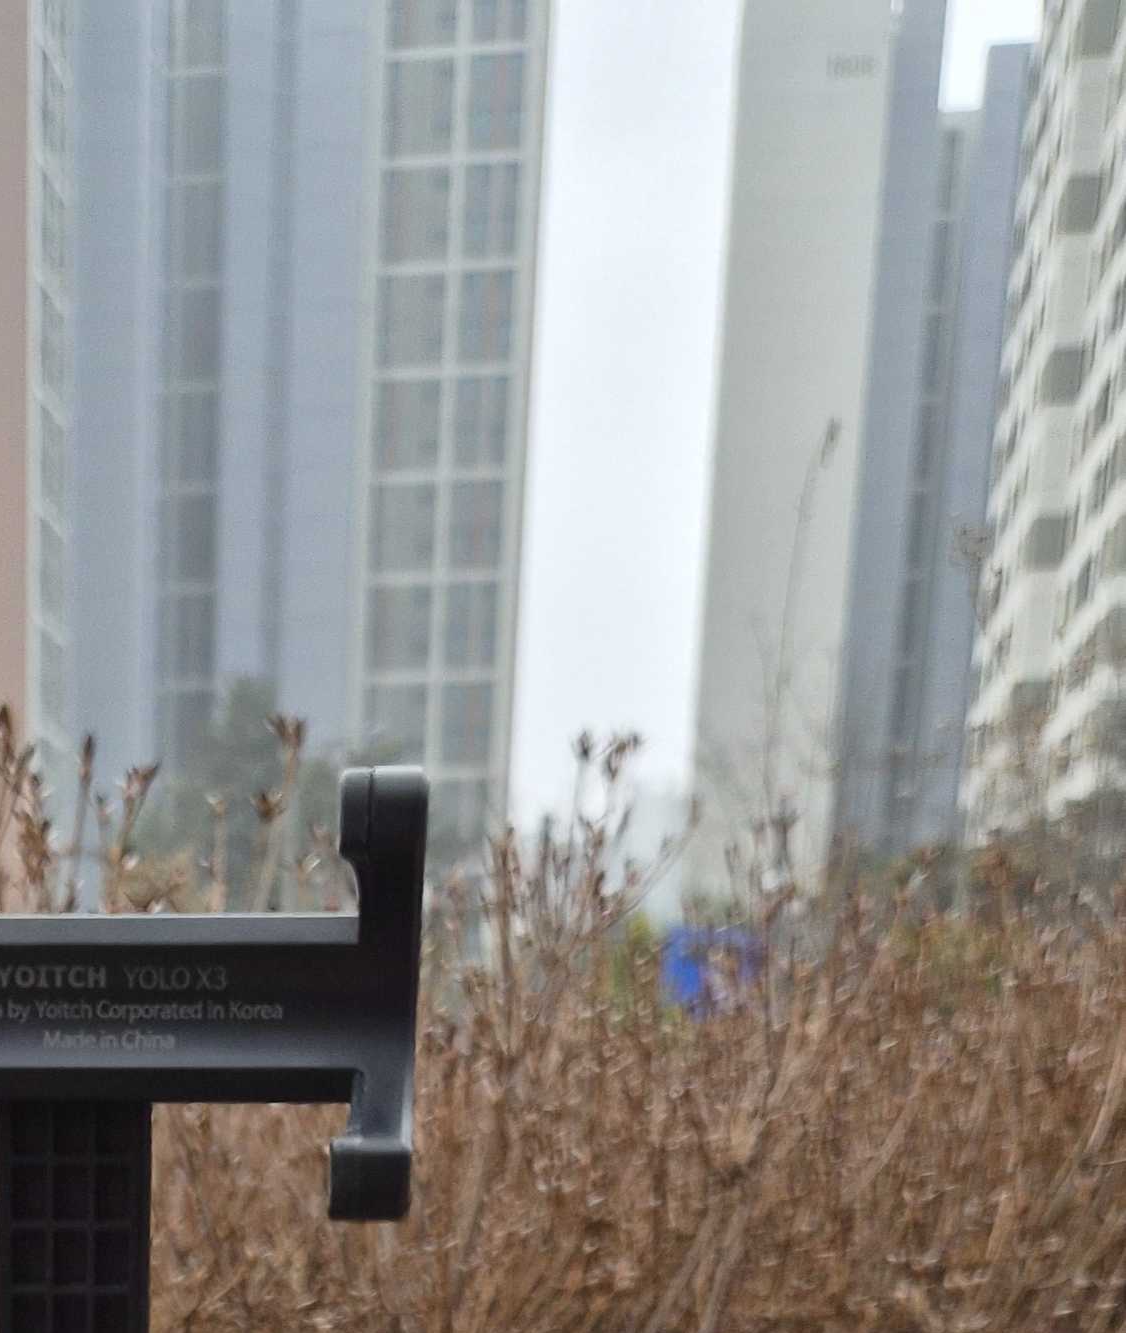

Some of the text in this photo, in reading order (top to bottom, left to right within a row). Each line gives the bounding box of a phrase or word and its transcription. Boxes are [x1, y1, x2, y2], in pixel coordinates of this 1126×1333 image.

[7, 999, 31, 1024] by
[34, 999, 93, 1019] Yoitch
[96, 999, 204, 1023] Corporated
[229, 999, 283, 1019] Korea
[43, 1029, 176, 1048] Made in China
